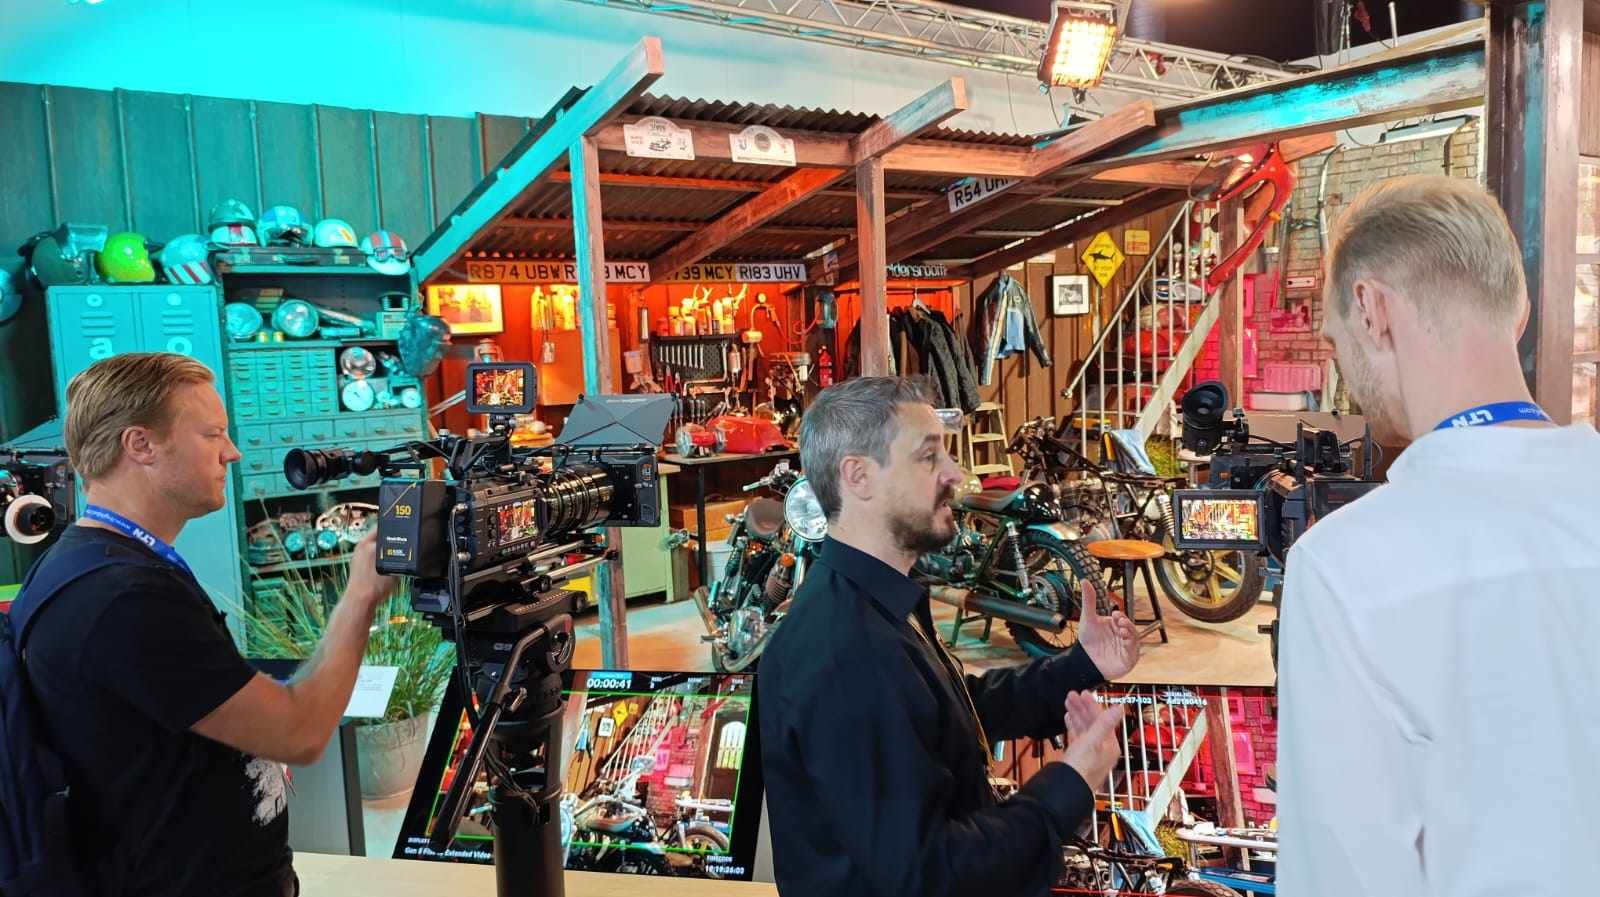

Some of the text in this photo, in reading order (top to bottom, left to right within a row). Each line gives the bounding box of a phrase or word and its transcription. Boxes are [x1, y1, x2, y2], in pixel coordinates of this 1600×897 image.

[954, 181, 981, 207] R54
[469, 264, 560, 279] R874 UBW
[615, 265, 646, 279] MCY
[666, 266, 733, 280] 739 MCY
[739, 266, 801, 279] R183 UHV
[1451, 410, 1494, 427] LTN
[395, 504, 412, 516] 150
[132, 528, 156, 546] LTN
[586, 678, 632, 689] 00:00:41
